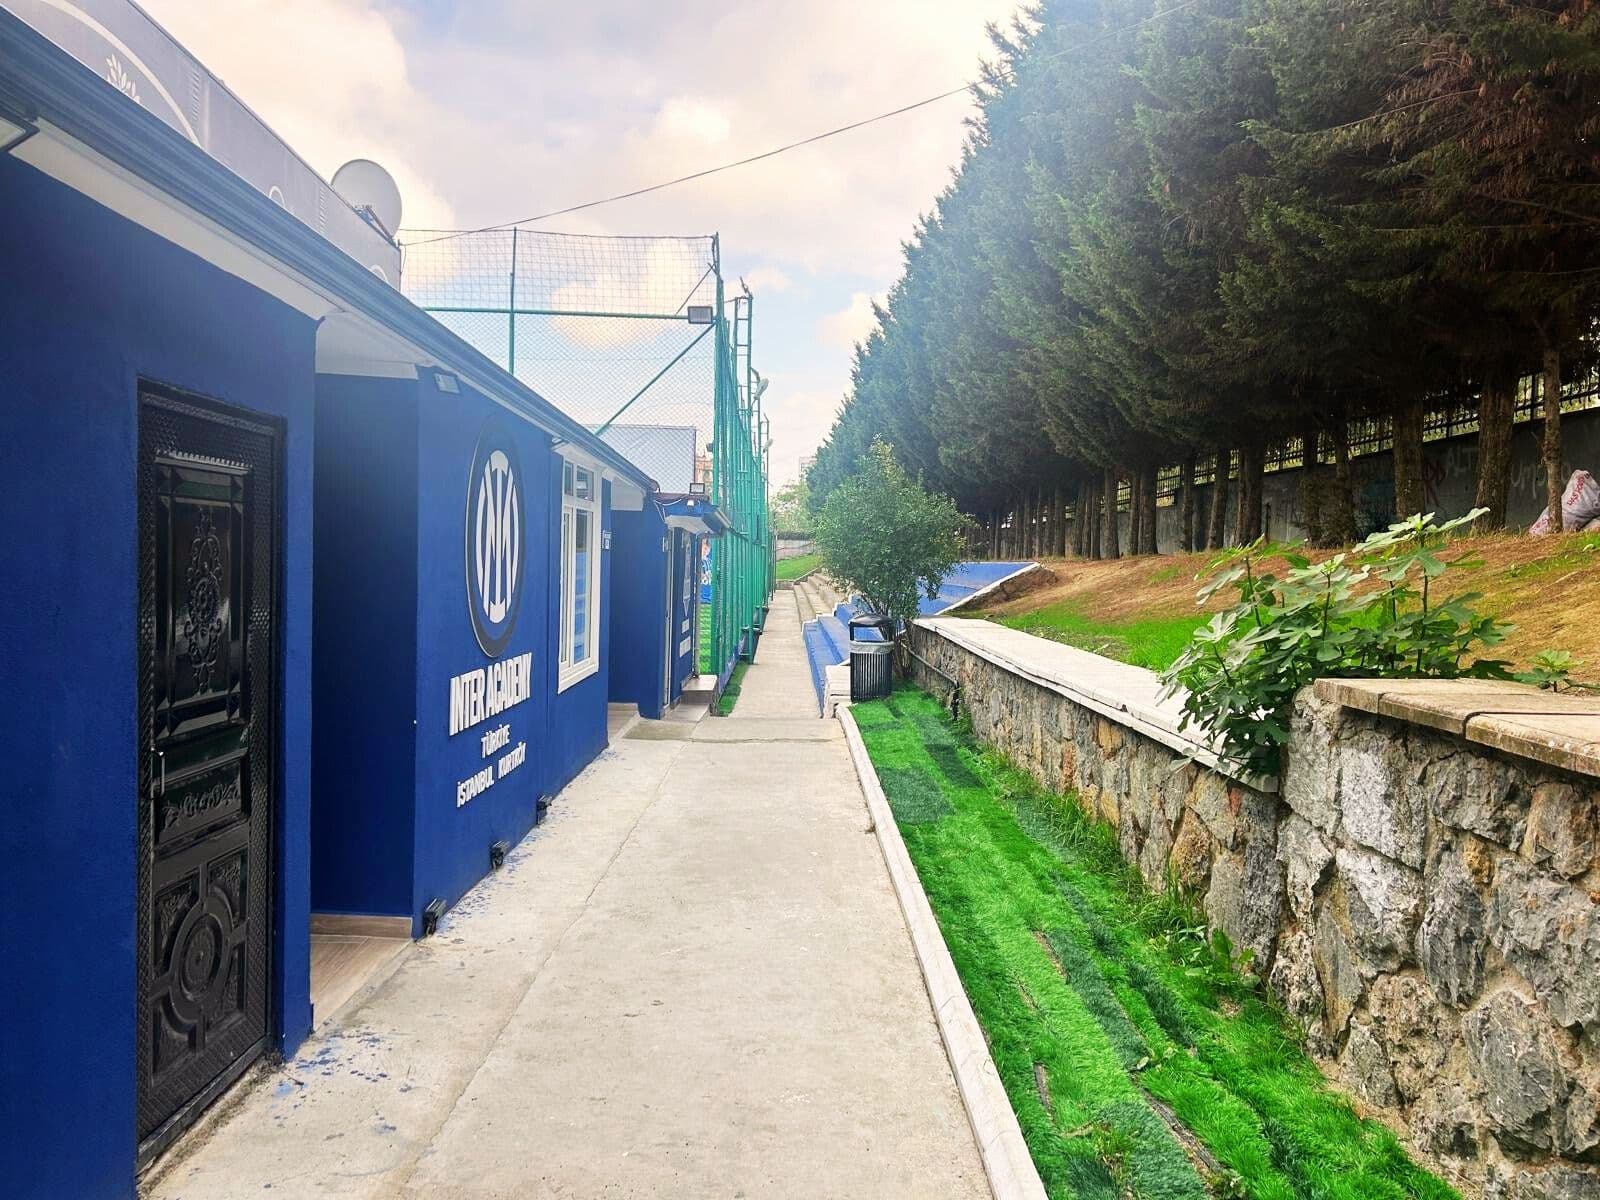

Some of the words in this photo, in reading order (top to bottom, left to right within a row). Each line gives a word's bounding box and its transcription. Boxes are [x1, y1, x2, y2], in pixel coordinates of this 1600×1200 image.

[449, 668, 486, 736] INTER
[485, 652, 532, 719] ACADEMY
[481, 724, 510, 758] TÜRKİYE
[456, 766, 495, 808] İSTANBUL
[498, 742, 526, 779] KURTKÖY
